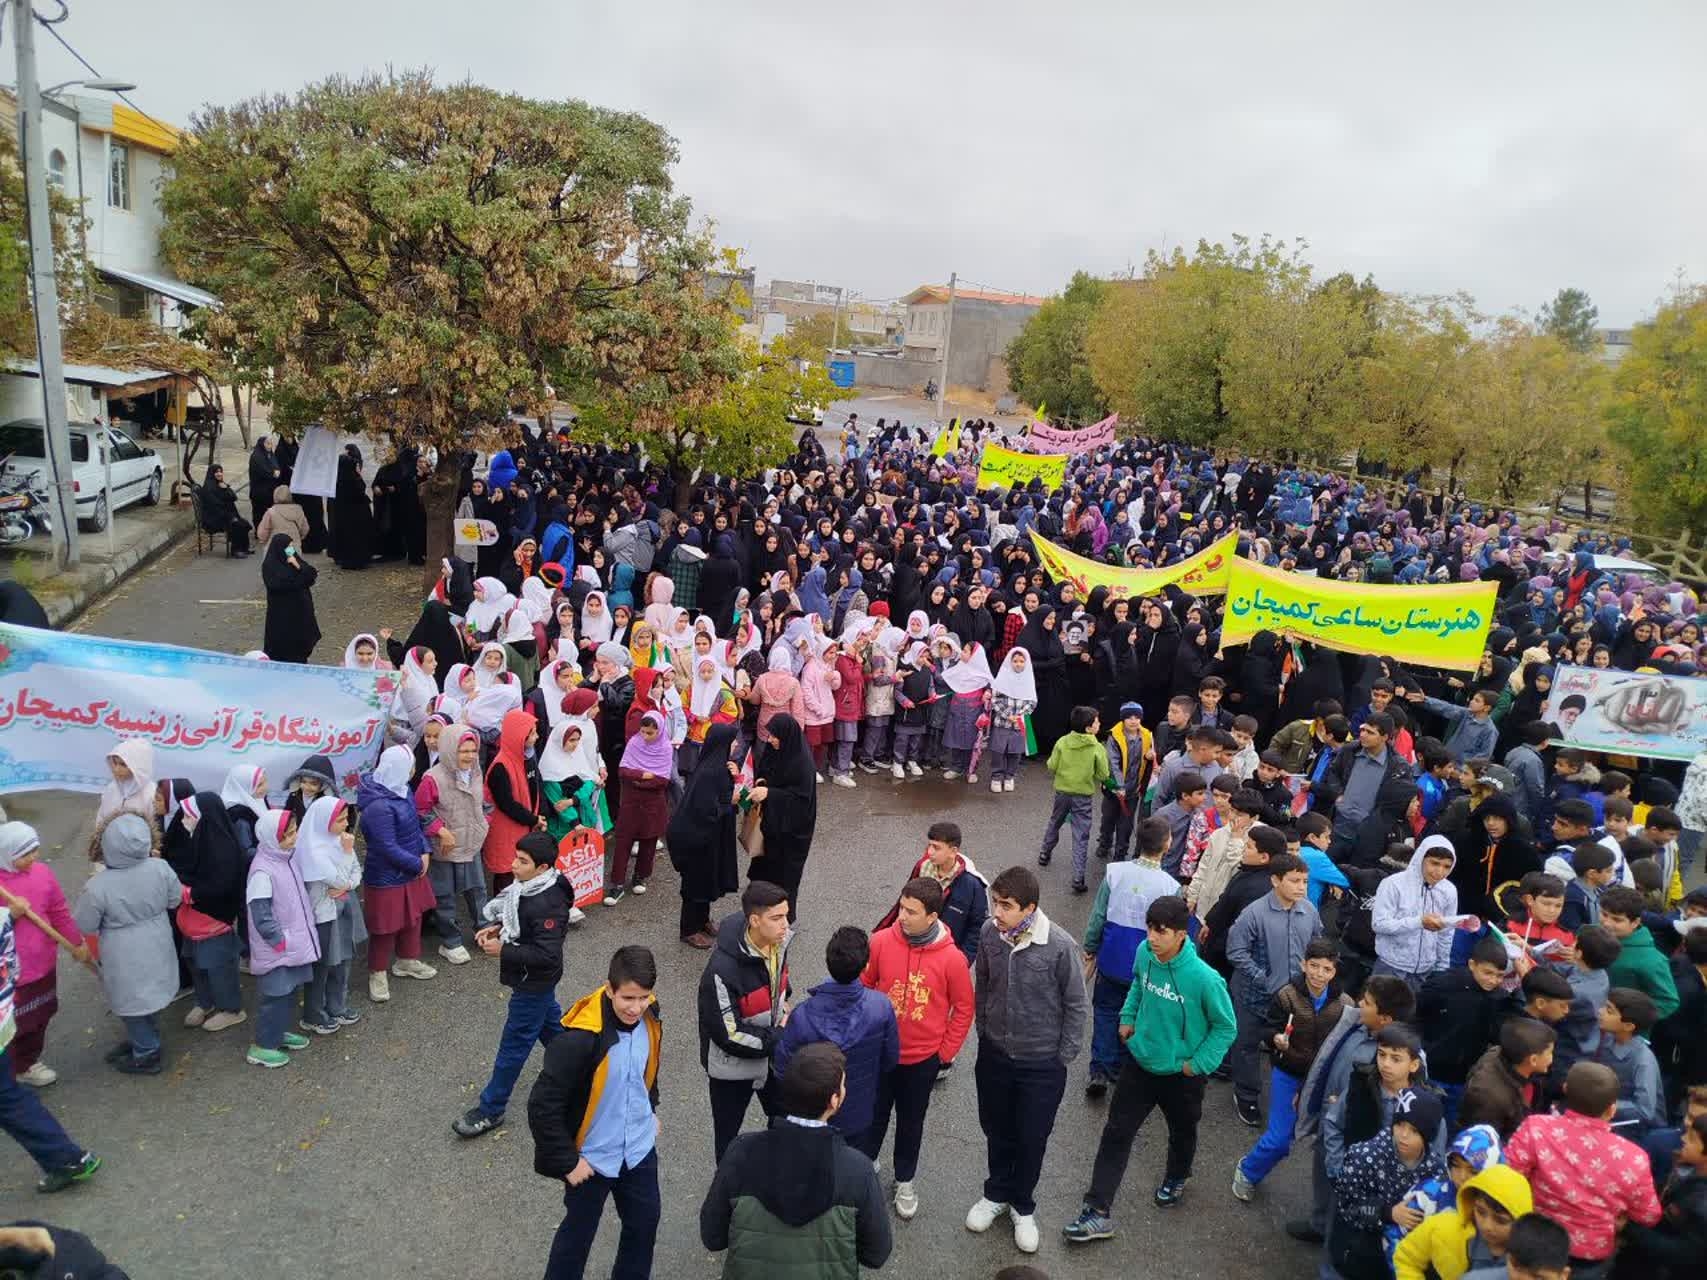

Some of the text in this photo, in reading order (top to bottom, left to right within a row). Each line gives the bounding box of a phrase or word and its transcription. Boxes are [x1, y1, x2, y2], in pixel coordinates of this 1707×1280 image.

[1232, 588, 1481, 638] هنرستان ساعی کمیجان
[103, 709, 182, 746] زینبیه
[181, 707, 265, 749] قرآنی
[263, 714, 380, 754] آموزشگاه
[559, 844, 597, 867] USA
